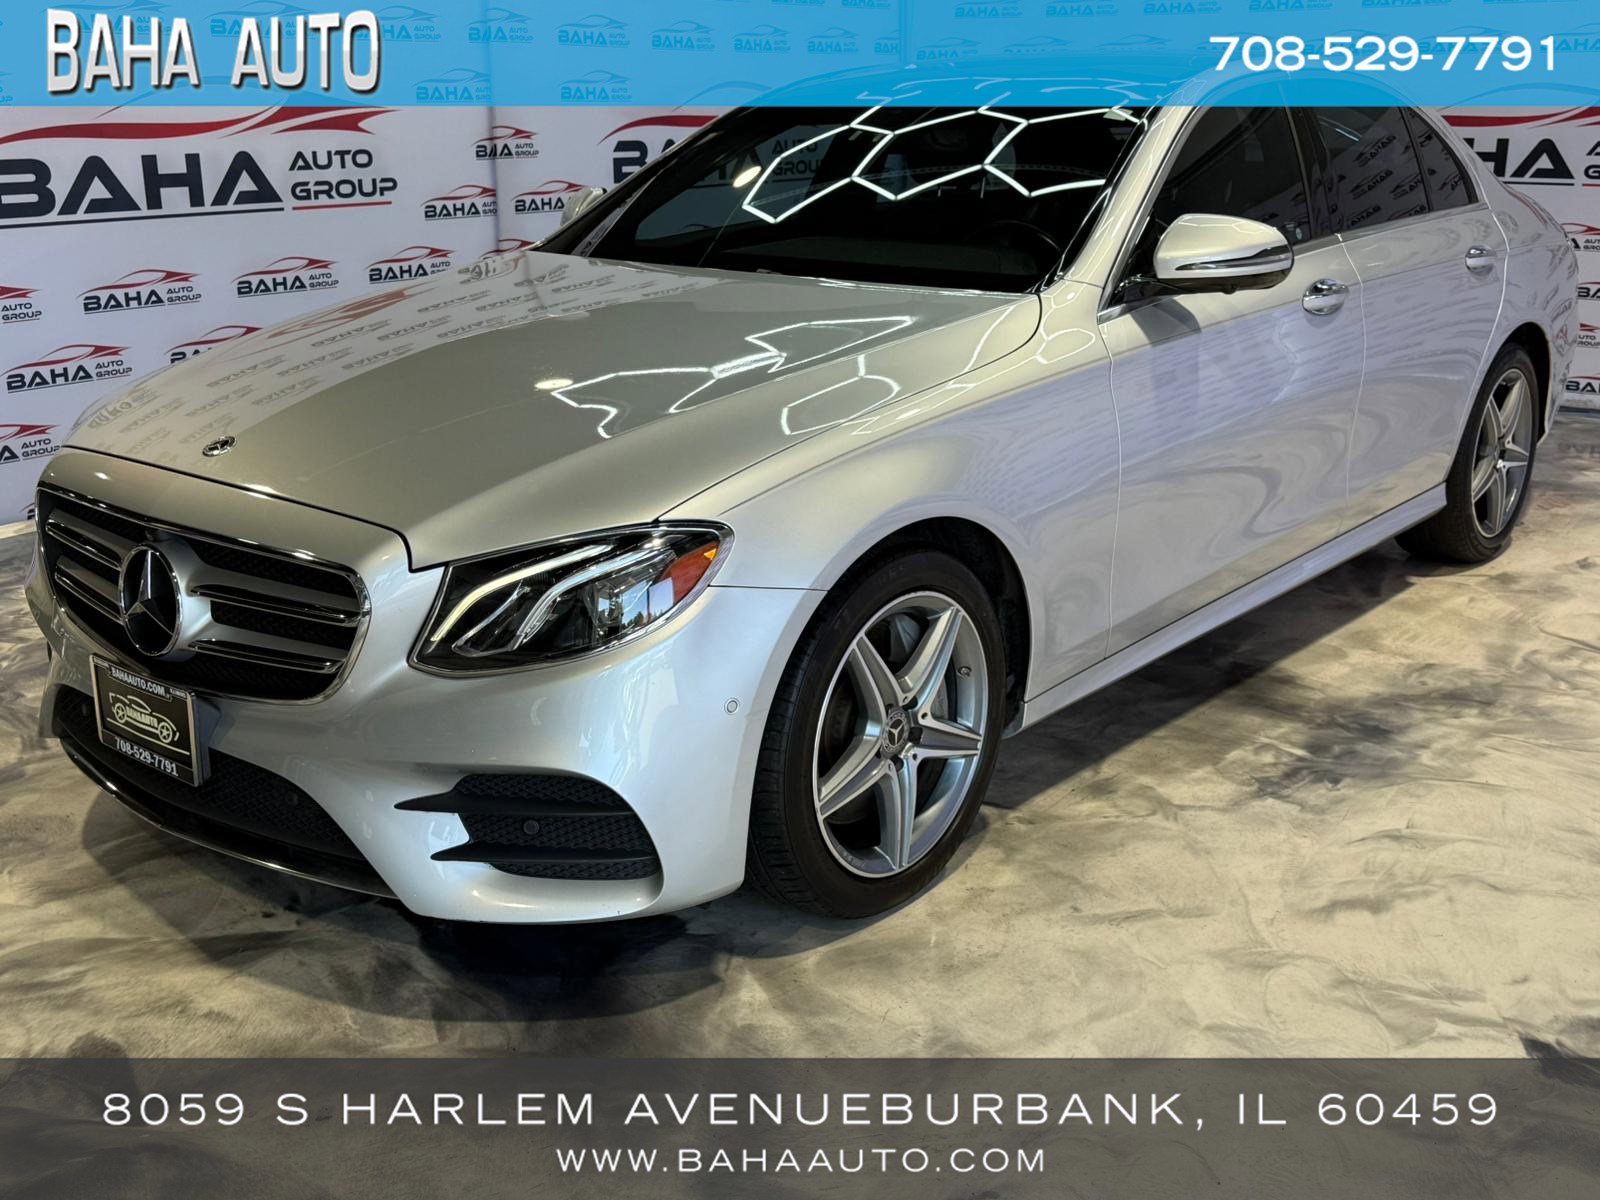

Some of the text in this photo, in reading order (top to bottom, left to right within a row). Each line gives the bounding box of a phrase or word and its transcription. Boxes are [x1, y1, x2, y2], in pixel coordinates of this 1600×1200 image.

[955, 6, 1000, 17] BAHA
[1046, 5, 1095, 17] BAHA
[1143, 2, 1196, 15] BAHA
[558, 29, 607, 46] BAHA
[651, 34, 697, 50] BAHA
[734, 38, 773, 52] BAHA
[808, 41, 843, 53] BAHA
[416, 86, 472, 102] BAHA
[561, 85, 609, 101] BAHA
[288, 149, 374, 171] AUTO
[773, 160, 822, 176] GROU
[0, 150, 284, 219] BAHA
[290, 178, 398, 201] GROUP
[424, 202, 481, 219] BAHA
[514, 196, 565, 212] BAHA
[369, 263, 428, 282] BAHA
[430, 261, 451, 269] AUTO
[308, 272, 332, 281] AUTO
[308, 279, 339, 289] GROUP
[166, 285, 194, 294] AUTO
[237, 274, 307, 295] BAHA
[83, 289, 164, 313] BAHA
[166, 293, 202, 303] GROUP
[1, 302, 33, 312] AUTO
[2, 310, 42, 320] GROUP
[95, 359, 124, 369] AUTO
[6, 363, 93, 392] BAHA
[95, 367, 133, 378] GROUP
[21, 438, 52, 450] AUTO
[22, 445, 61, 458] GROUP
[112, 667, 165, 696] BAHAAUTO.COM
[114, 736, 179, 777] 708-529-7791
